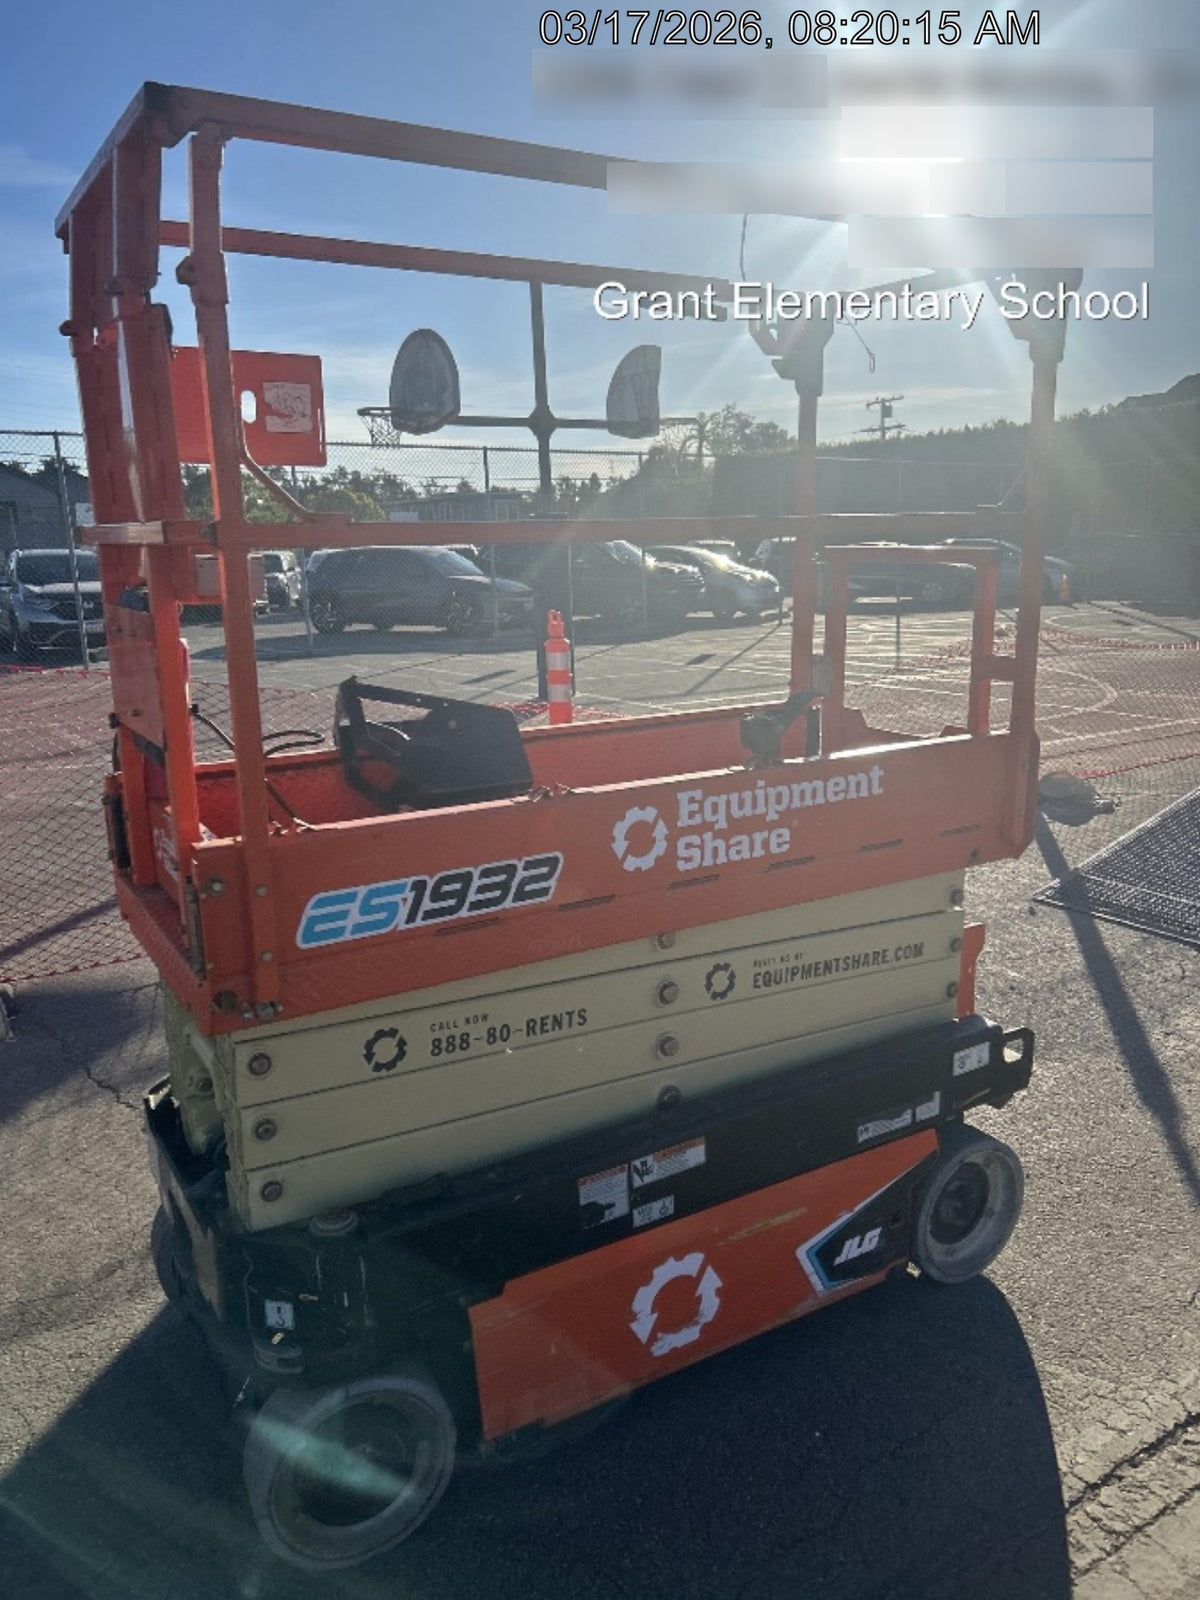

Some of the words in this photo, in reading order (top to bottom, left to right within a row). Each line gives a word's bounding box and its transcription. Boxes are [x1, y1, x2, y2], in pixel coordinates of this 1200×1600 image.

[676, 765, 885, 829] Equipment
[676, 827, 791, 872] Share
[298, 852, 562, 947] ES1932
[753, 942, 925, 989] EQUIPMENTSHARE.COM
[430, 1021, 459, 1033] CALL
[430, 1008, 588, 1056] 888-80-RENTS
